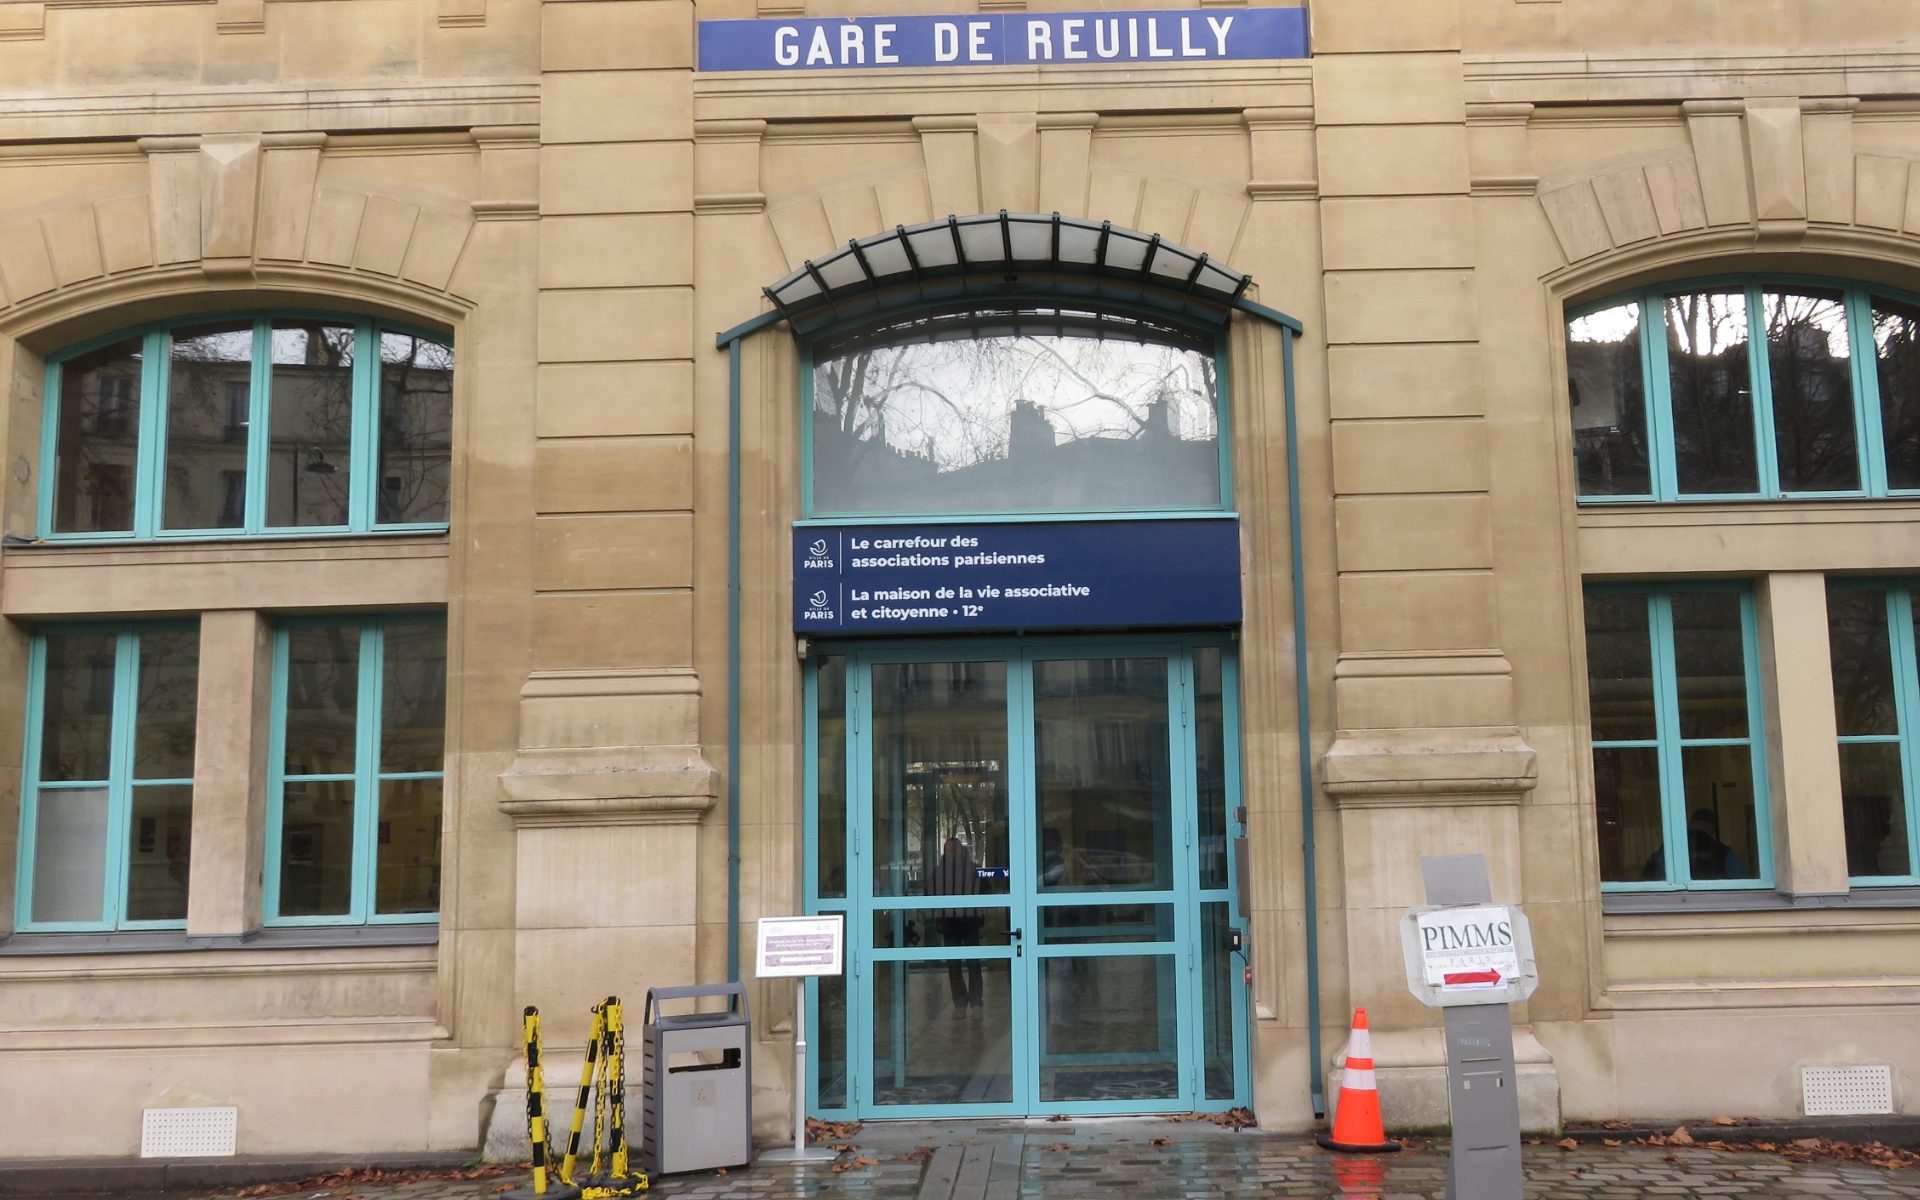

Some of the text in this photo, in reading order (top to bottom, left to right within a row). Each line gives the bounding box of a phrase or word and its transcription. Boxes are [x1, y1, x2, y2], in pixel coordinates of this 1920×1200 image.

[774, 17, 1234, 66] GARE DE REUILLY
[851, 535, 979, 550] Le carrefour des
[804, 560, 834, 569] PARIS
[852, 552, 1046, 569] associations parisiennes
[851, 583, 1091, 601] La maison de la vie associative
[804, 611, 834, 620] PARIS
[851, 607, 868, 619] et
[871, 605, 948, 620] citoyenne
[1421, 922, 1512, 951] PIMMS
